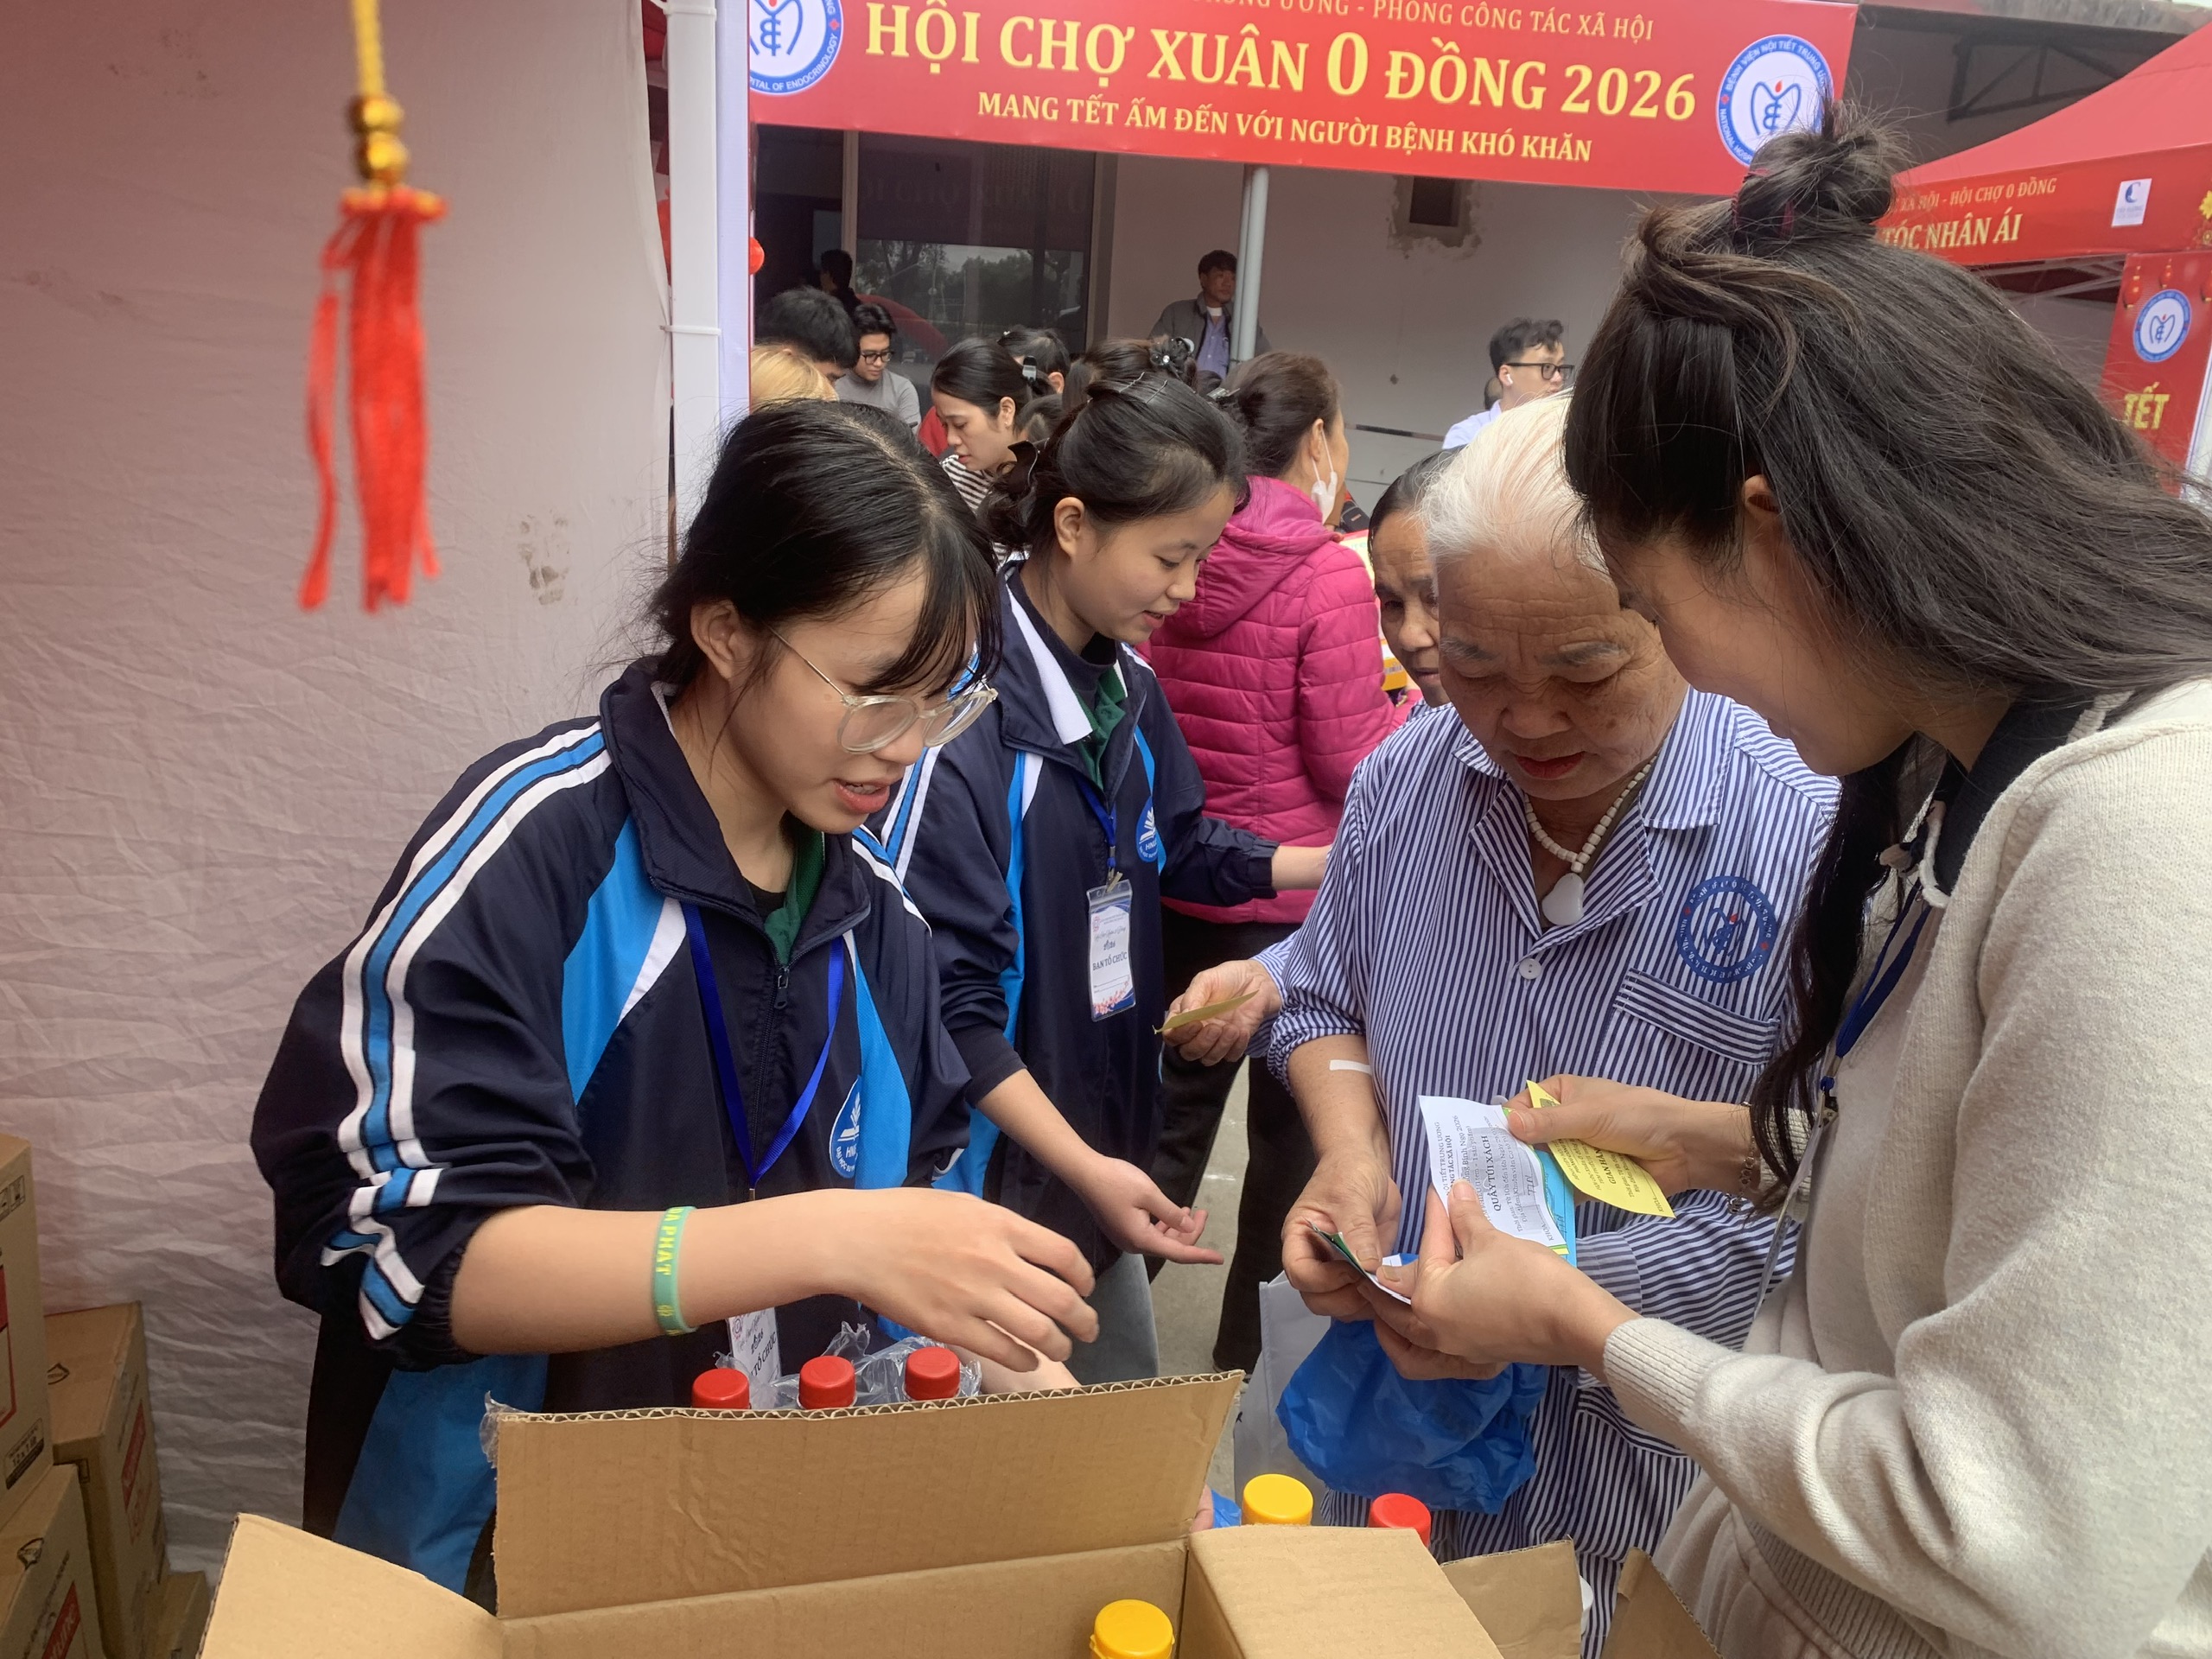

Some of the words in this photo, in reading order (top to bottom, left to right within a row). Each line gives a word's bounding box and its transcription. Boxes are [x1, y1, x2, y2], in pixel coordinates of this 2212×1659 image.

[1460, 1, 1522, 30] CÔNG
[1529, 7, 1571, 35] TÁC
[1577, 11, 1605, 37] XÃ
[1613, 14, 1654, 44] HỘI
[772, 82, 785, 91] OF
[785, 34, 838, 90] ENDOCRINOLOGY
[866, 0, 981, 74] HỘI
[999, 16, 1135, 87] CHỢ
[1147, 23, 1309, 92] XUÂN
[1327, 31, 1369, 96] 0
[1385, 36, 1547, 111] ĐỒNG
[1560, 64, 1695, 121] 2026
[978, 92, 1059, 122] MANG
[1066, 93, 1119, 125] TẾT
[1124, 97, 1167, 130] ẤM
[1173, 103, 1228, 135] ĐẾN
[1236, 109, 1284, 141] VỚI
[1290, 116, 1379, 148] NGƯỜI
[1384, 120, 1455, 156] BỆNH
[1460, 127, 1516, 157] KHÓ
[1521, 131, 1592, 162] KHĂN
[1949, 186, 1973, 208] HỘI
[1974, 184, 2004, 204] CHỢ
[2017, 176, 2057, 197] ĐỒNG
[1925, 212, 1993, 250] NHÂN
[1993, 207, 2024, 244] ÁI
[2124, 382, 2171, 429] TẾT
[1092, 959, 1104, 971] BAN
[1452, 1115, 1463, 1132] 2026
[1437, 1142, 1446, 1166] TRUNG
[1481, 1135, 1493, 1164] XÁCH
[1484, 1165, 1496, 1183] TÚI
[1602, 1166, 1617, 1185] GIAN
[656, 1225, 678, 1275] PHAT
